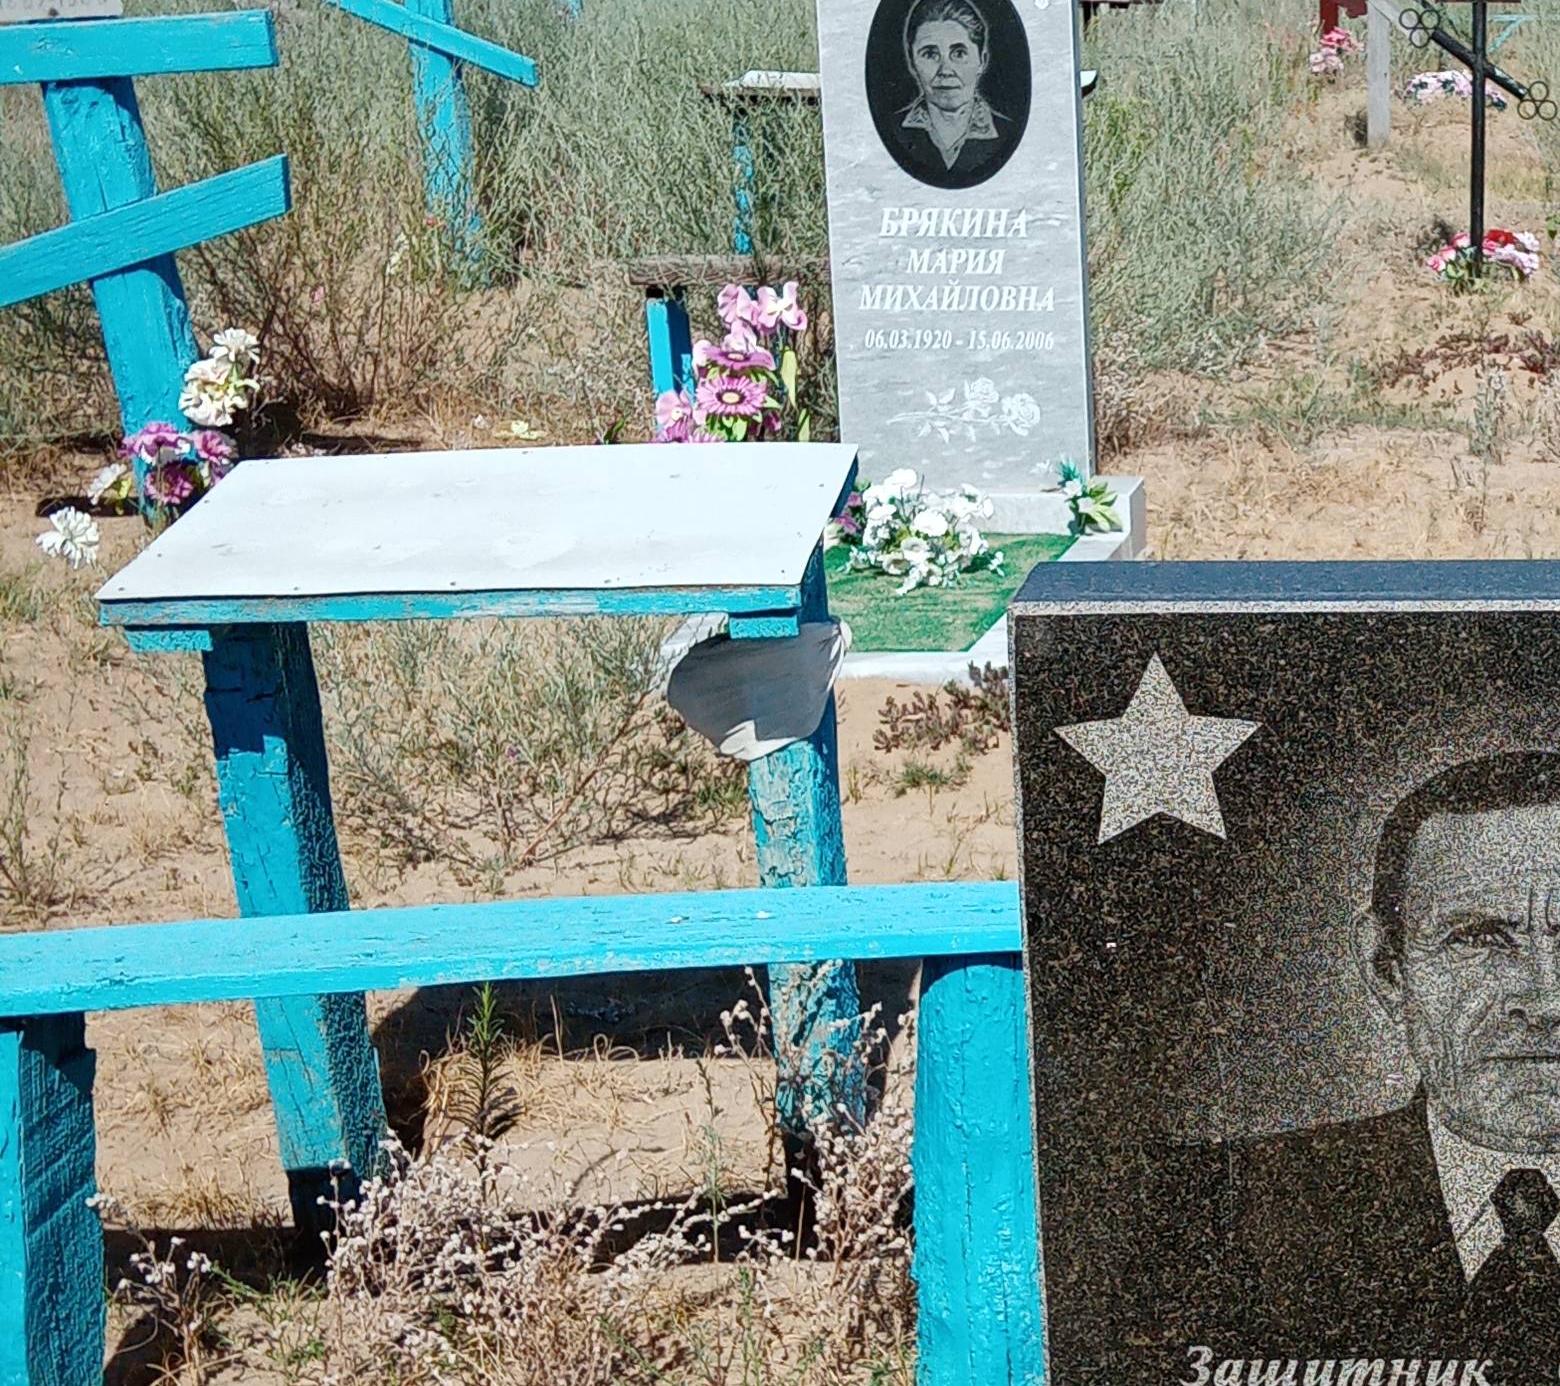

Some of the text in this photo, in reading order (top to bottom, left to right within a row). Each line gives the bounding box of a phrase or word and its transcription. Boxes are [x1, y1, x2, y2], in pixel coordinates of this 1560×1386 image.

[878, 206, 1028, 238] БРЯКИНА
[905, 248, 1007, 275] МАРИЯ
[858, 279, 1055, 311] МИХАЙЛОВНА
[864, 328, 951, 350] 06.03.1920
[966, 330, 1055, 351] 15.06.2006
